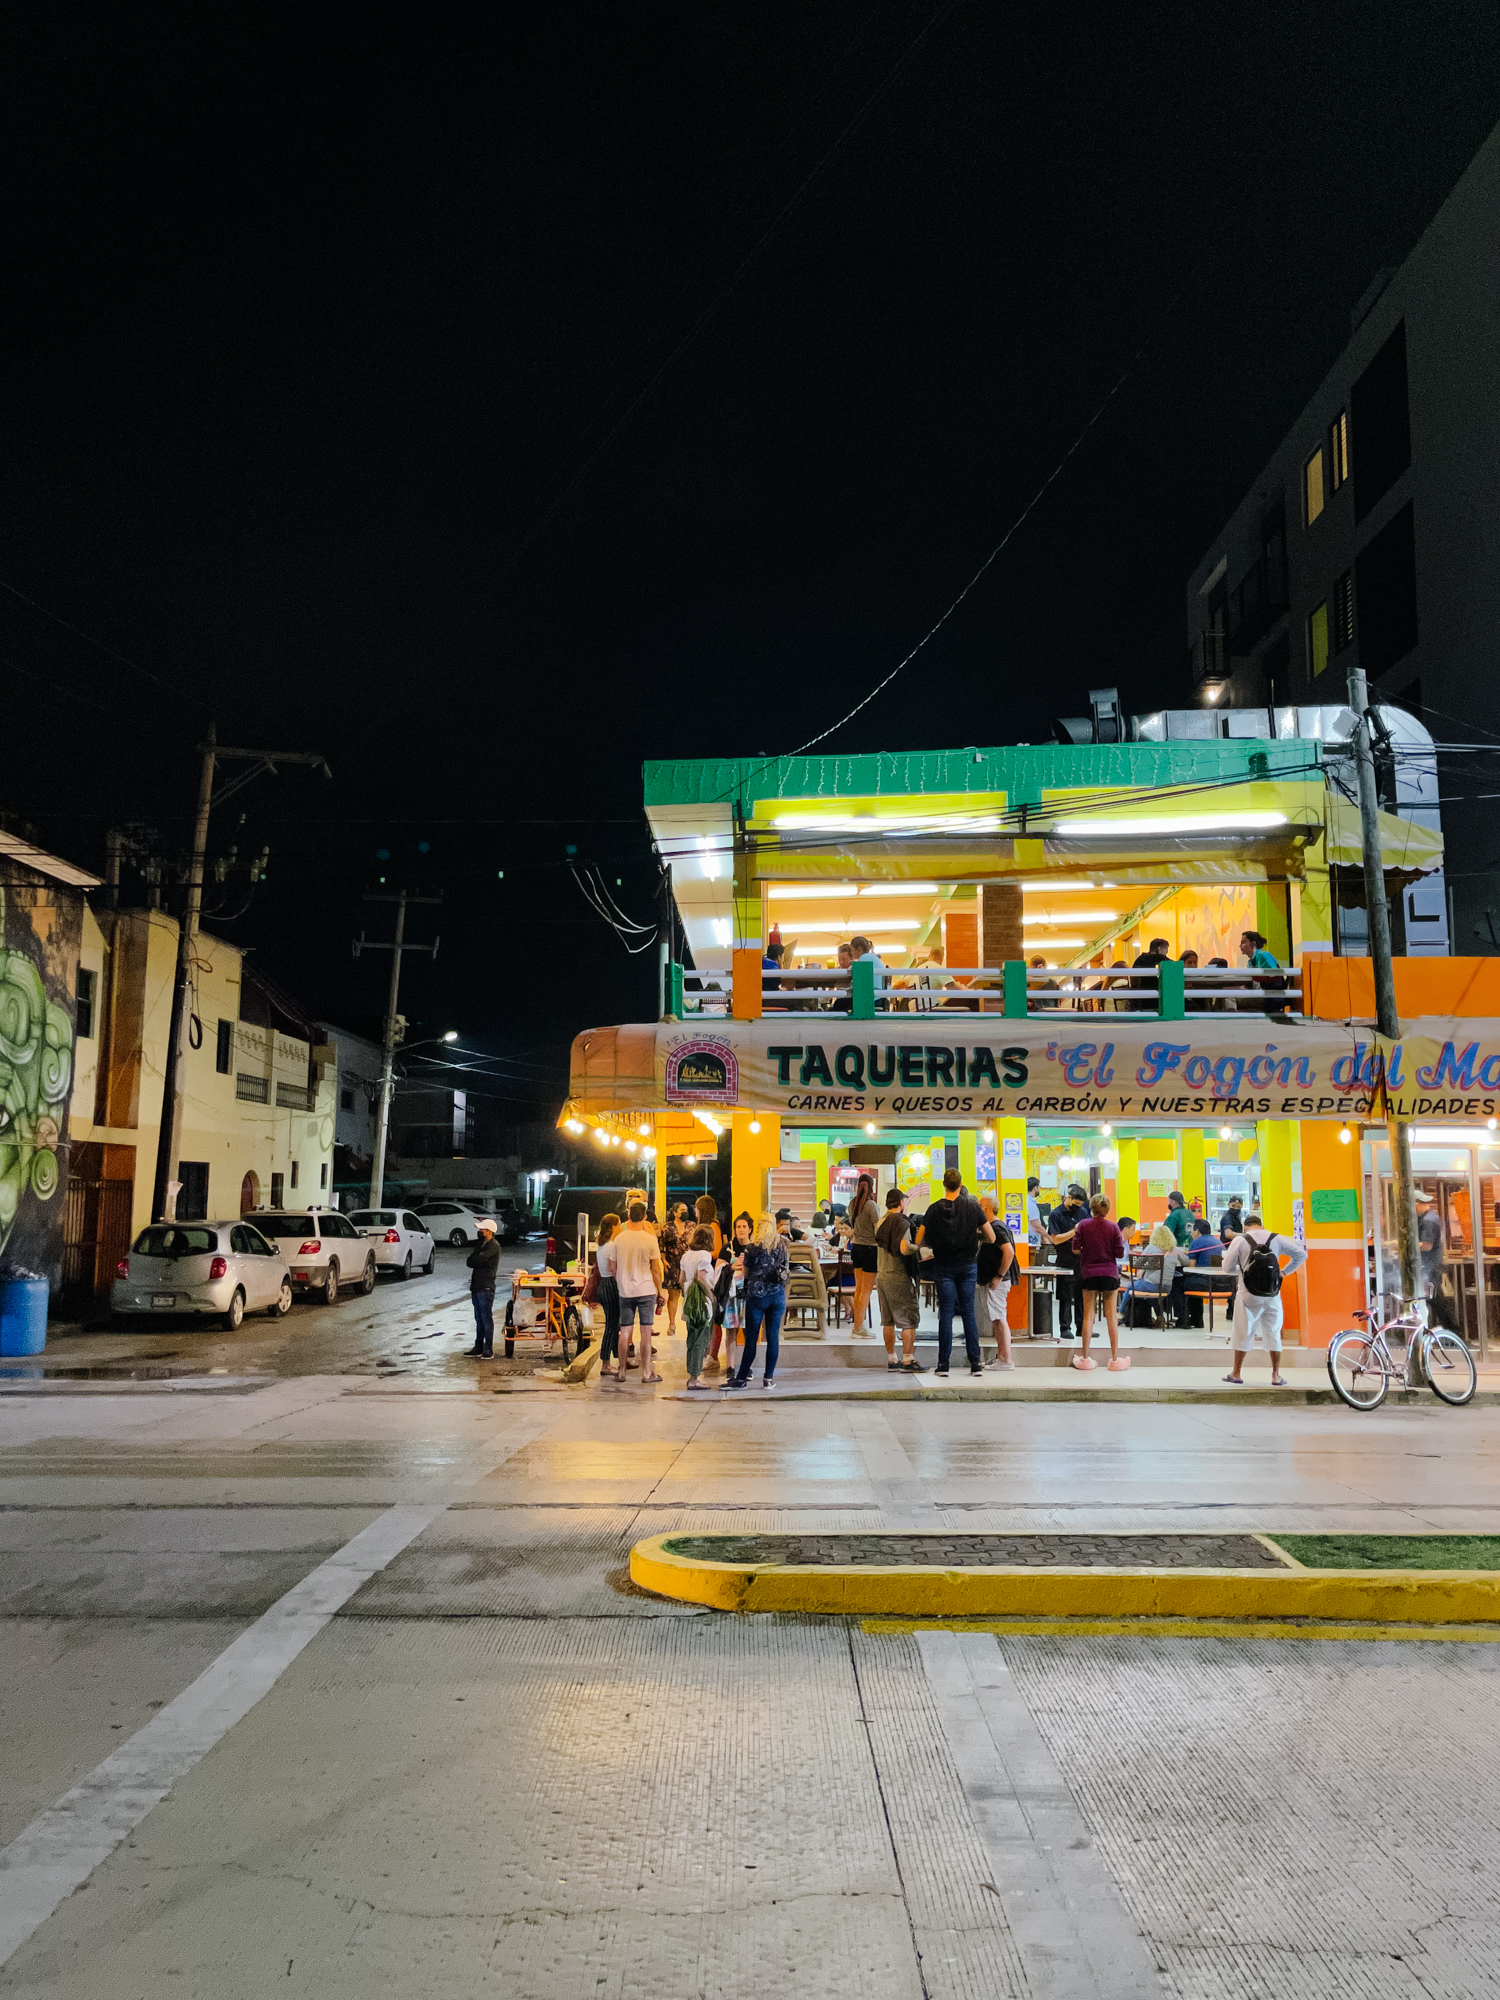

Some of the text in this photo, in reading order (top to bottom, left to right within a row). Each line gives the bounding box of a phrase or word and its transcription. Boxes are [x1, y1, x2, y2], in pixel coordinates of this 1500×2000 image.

[767, 1044, 1029, 1092] TAQUERIAS
[1135, 1041, 1316, 1099] Fogón
[1330, 1042, 1405, 1092] del
[787, 1095, 865, 1111] CARNES
[874, 1097, 886, 1112] Y
[891, 1096, 973, 1114] QUESOS
[982, 1097, 1005, 1111] AL
[1015, 1091, 1107, 1113] CARBÓN
[1119, 1097, 1133, 1113] Y
[1141, 1097, 1272, 1113] NUESTRAS
